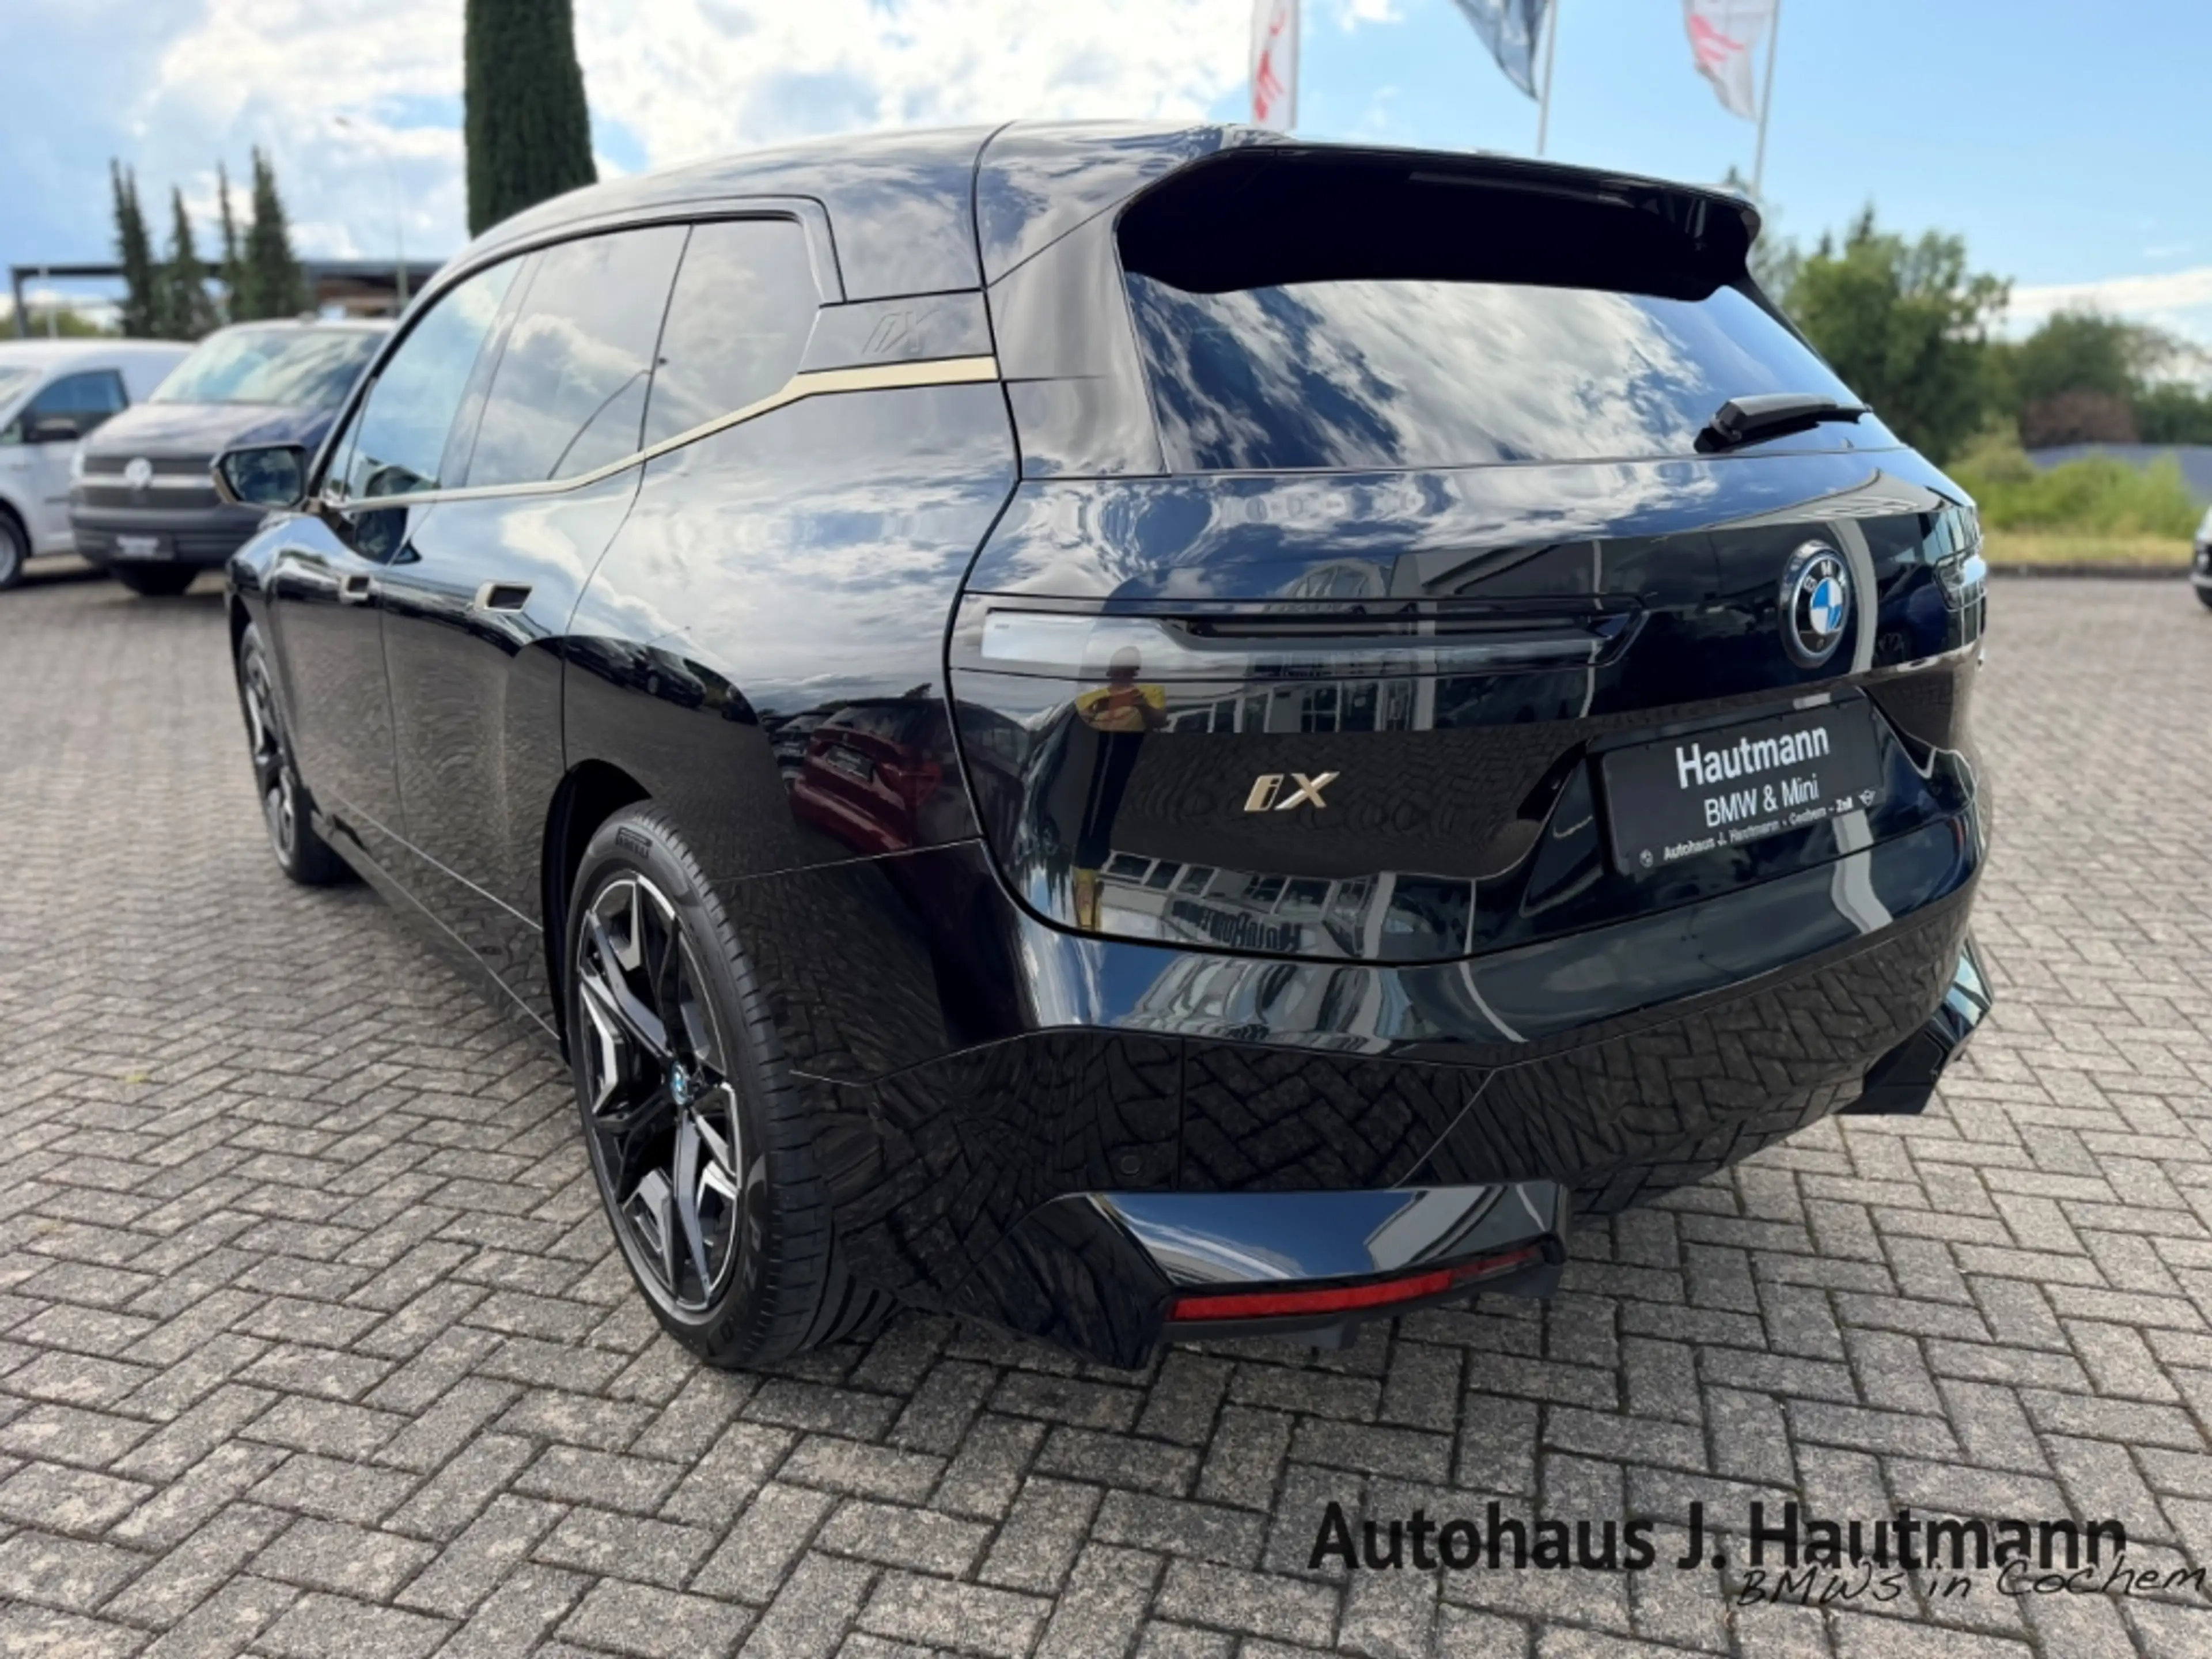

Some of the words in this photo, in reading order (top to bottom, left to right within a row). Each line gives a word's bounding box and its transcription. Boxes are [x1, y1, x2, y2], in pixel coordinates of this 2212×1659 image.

[1676, 726, 1830, 789] Hautmann
[1244, 770, 1340, 812] iX
[1704, 788, 1758, 828] BMW
[1763, 784, 1779, 812] &
[1782, 772, 1820, 808] Mini
[1663, 836, 1717, 861] Autohaus
